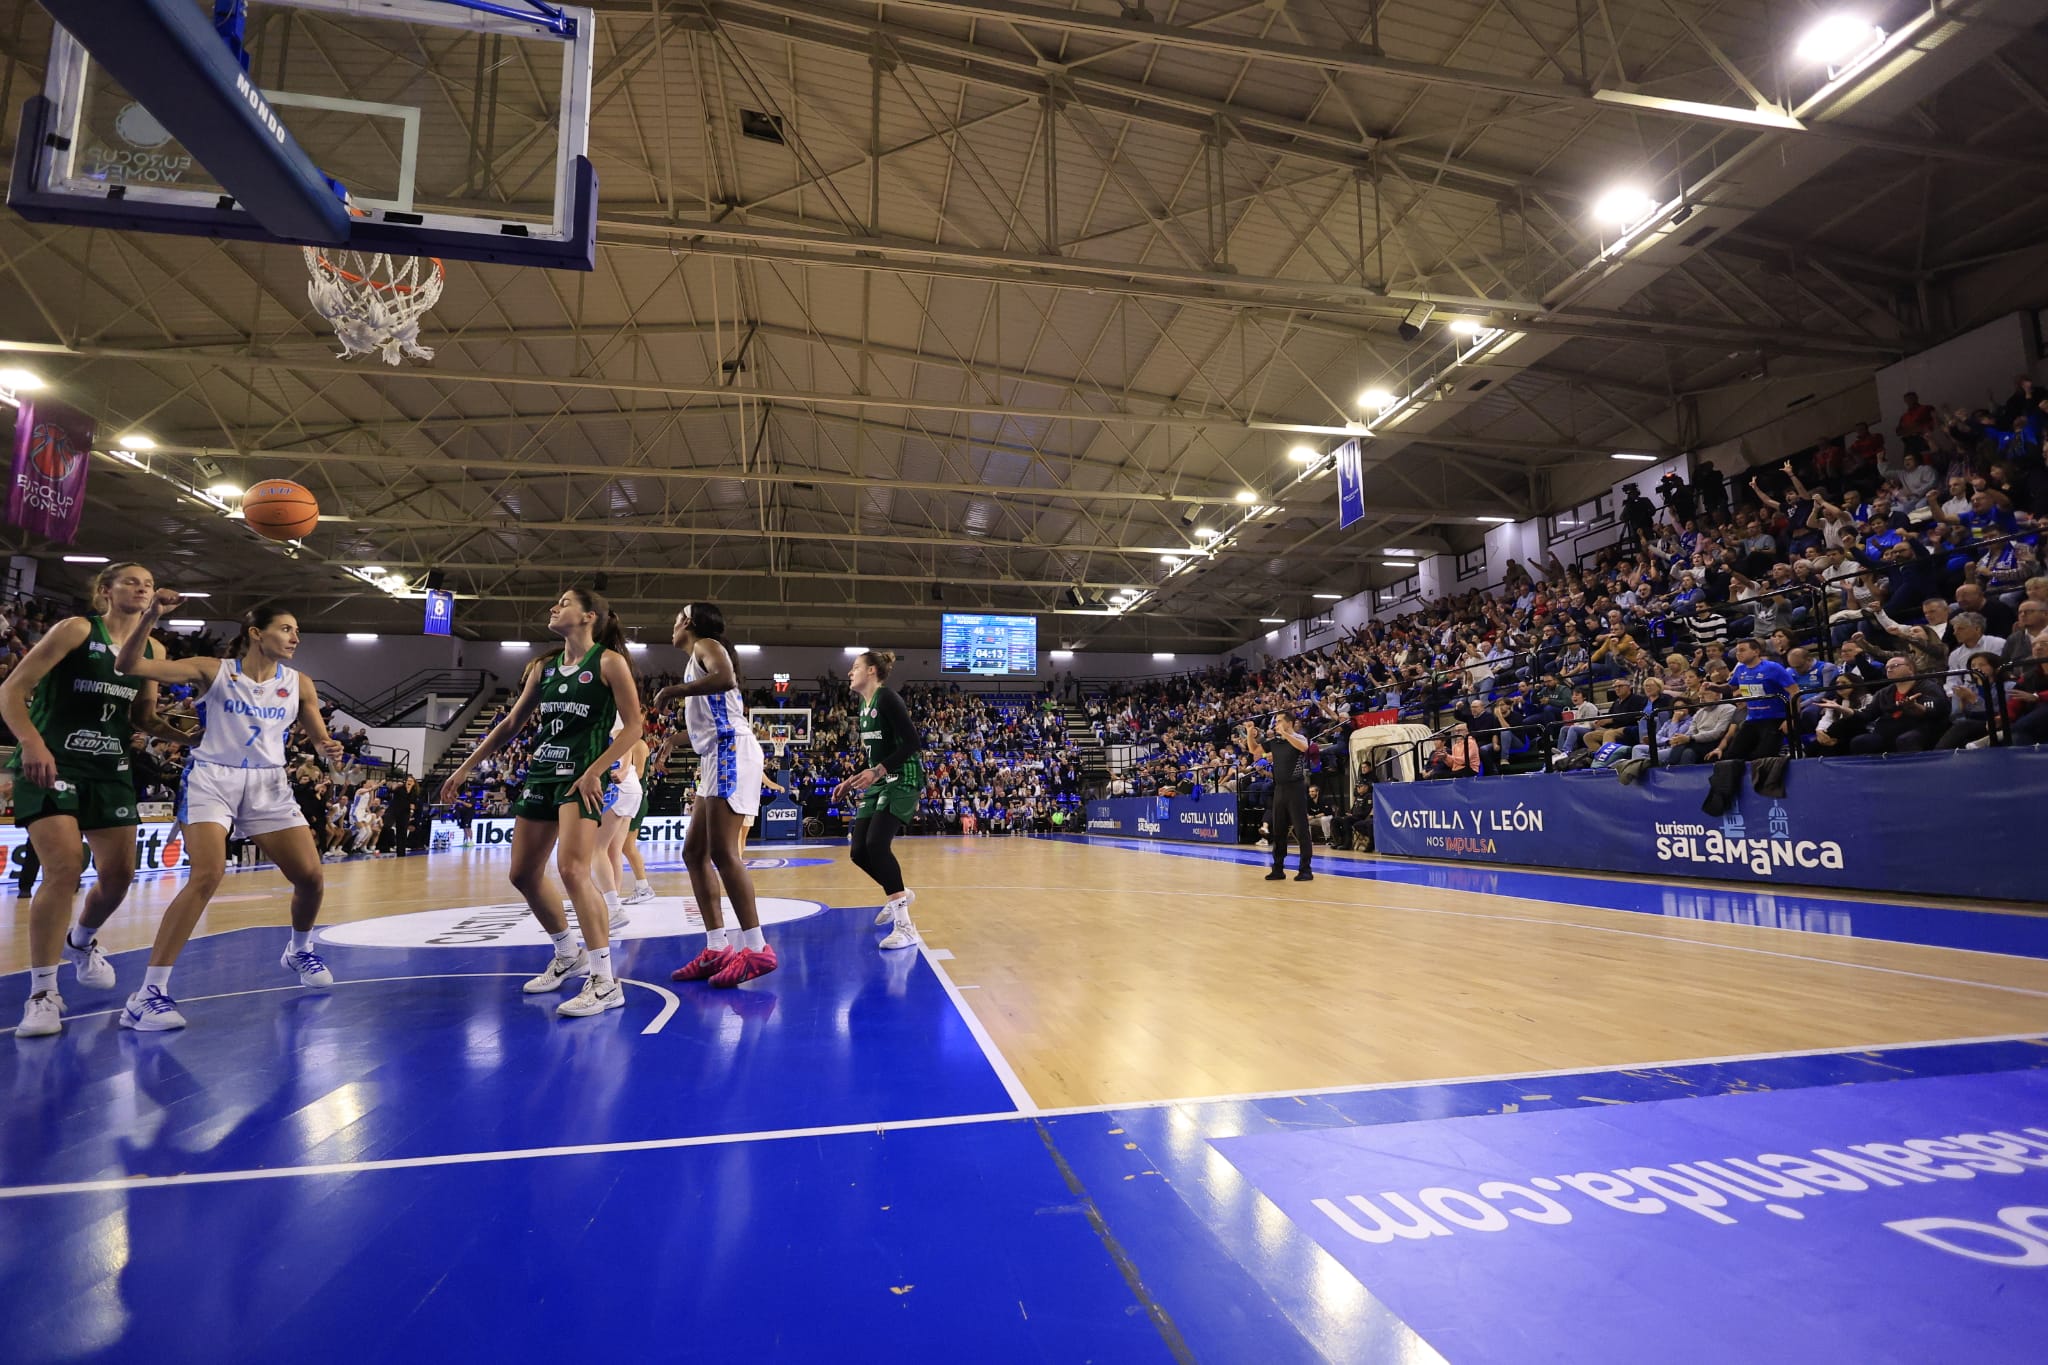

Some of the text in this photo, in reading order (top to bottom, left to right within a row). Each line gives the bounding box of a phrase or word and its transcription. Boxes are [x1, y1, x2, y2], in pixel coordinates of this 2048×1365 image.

[236, 73, 287, 144] MONDO
[435, 600, 444, 616] 8
[975, 648, 1004, 659] 04:13
[775, 683, 789, 692] 17
[223, 698, 287, 720] AVENIDA
[245, 725, 262, 747] 7
[1180, 807, 1235, 828] CASTILLA Y LEÓN
[1391, 802, 1544, 835] CASTILLA Y LEÓN
[476, 819, 686, 845] Ibe erit
[1655, 821, 1705, 836] turismo
[1426, 836, 1497, 855] NOS IMPULSA
